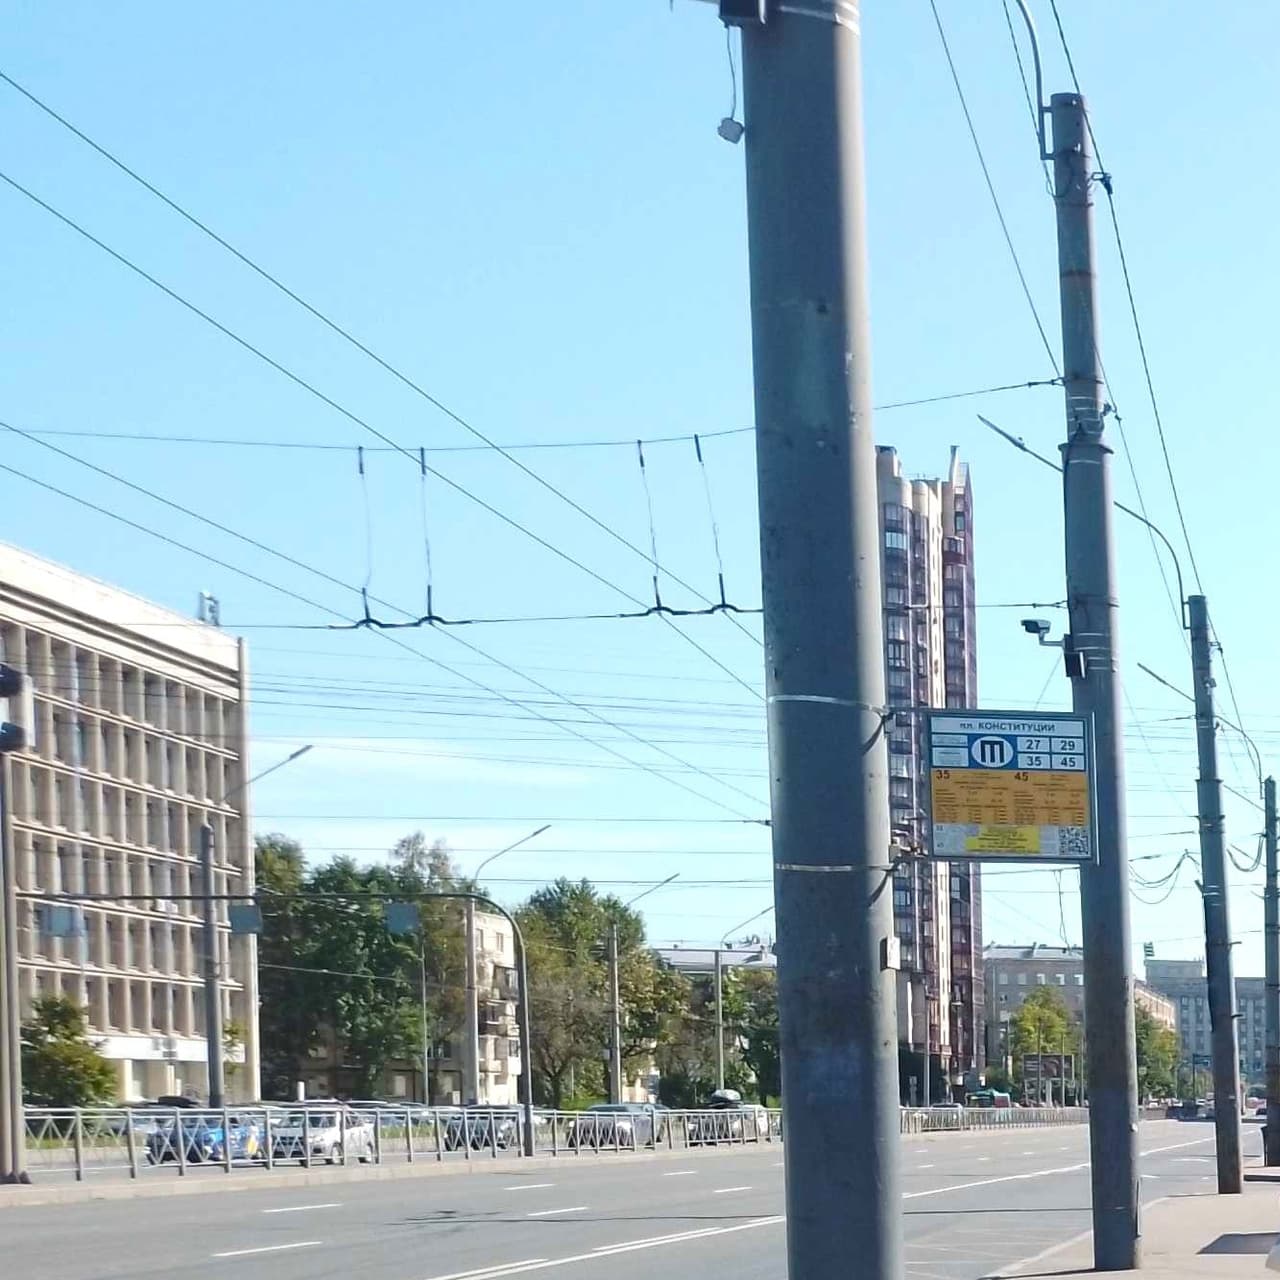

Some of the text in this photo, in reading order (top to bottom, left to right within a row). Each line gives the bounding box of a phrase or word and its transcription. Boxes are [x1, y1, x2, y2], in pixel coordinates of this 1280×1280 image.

[978, 721, 1056, 732] КОНСТИТУЦИИ
[1026, 740, 1041, 750] 27
[1060, 741, 1076, 751] 29
[1027, 757, 1042, 767] 35
[1060, 757, 1076, 767] 45
[936, 770, 950, 780] 35
[1015, 772, 1029, 782] 45
